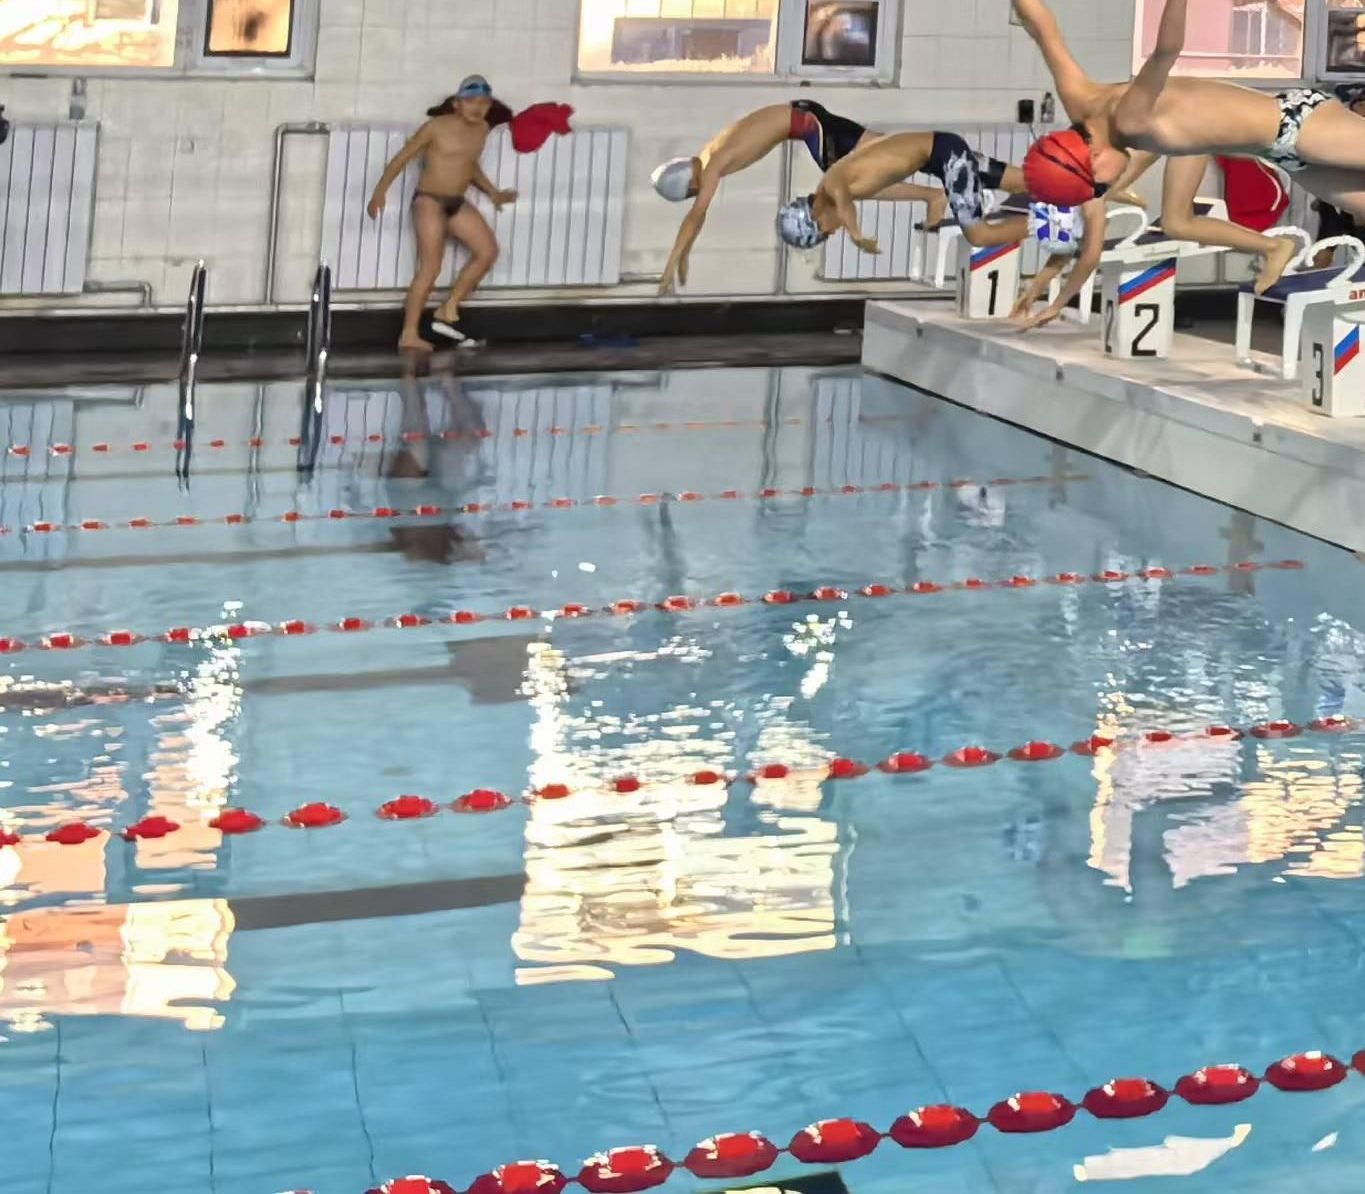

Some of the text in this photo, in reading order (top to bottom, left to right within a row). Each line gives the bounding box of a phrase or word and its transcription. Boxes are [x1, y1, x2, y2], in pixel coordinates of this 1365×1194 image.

[988, 270, 1000, 316] 1
[1131, 304, 1160, 357] 2
[1312, 343, 1324, 406] 3
